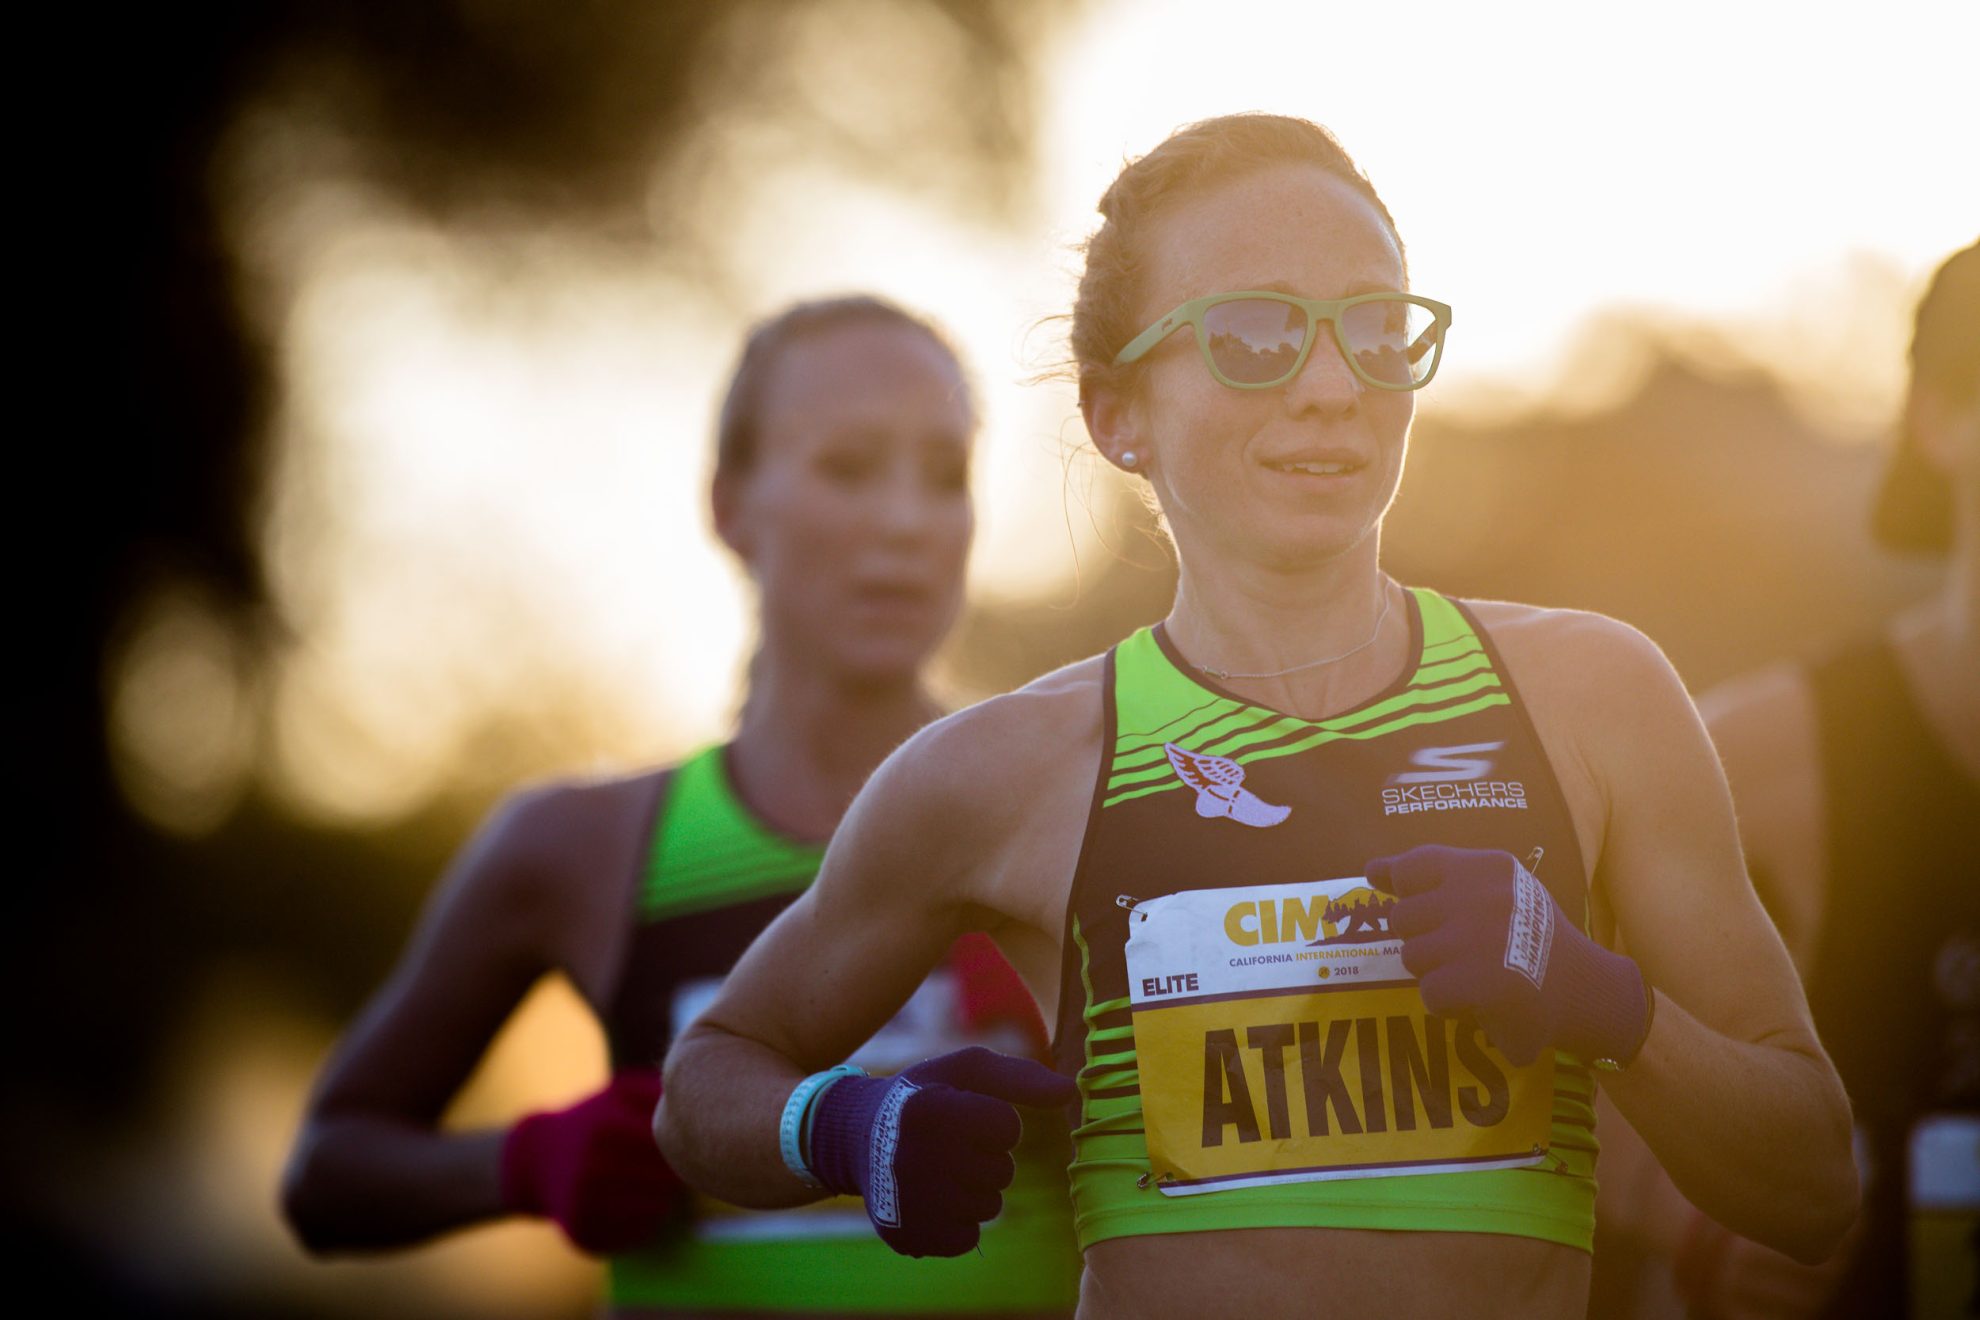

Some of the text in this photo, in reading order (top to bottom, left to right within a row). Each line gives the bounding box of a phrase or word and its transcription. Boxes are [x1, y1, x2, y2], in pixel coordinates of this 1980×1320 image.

[1381, 781, 1526, 805] SKECHERS
[1384, 798, 1528, 816] PERFORMANCE
[1223, 894, 1339, 947] CIM
[1229, 953, 1293, 967] CALIFORNIA
[1295, 947, 1380, 961] INTERNATIONAL
[1334, 966, 1360, 976] 2018
[1142, 972, 1199, 997] ELITE
[1201, 1015, 1510, 1148] ATKINS
